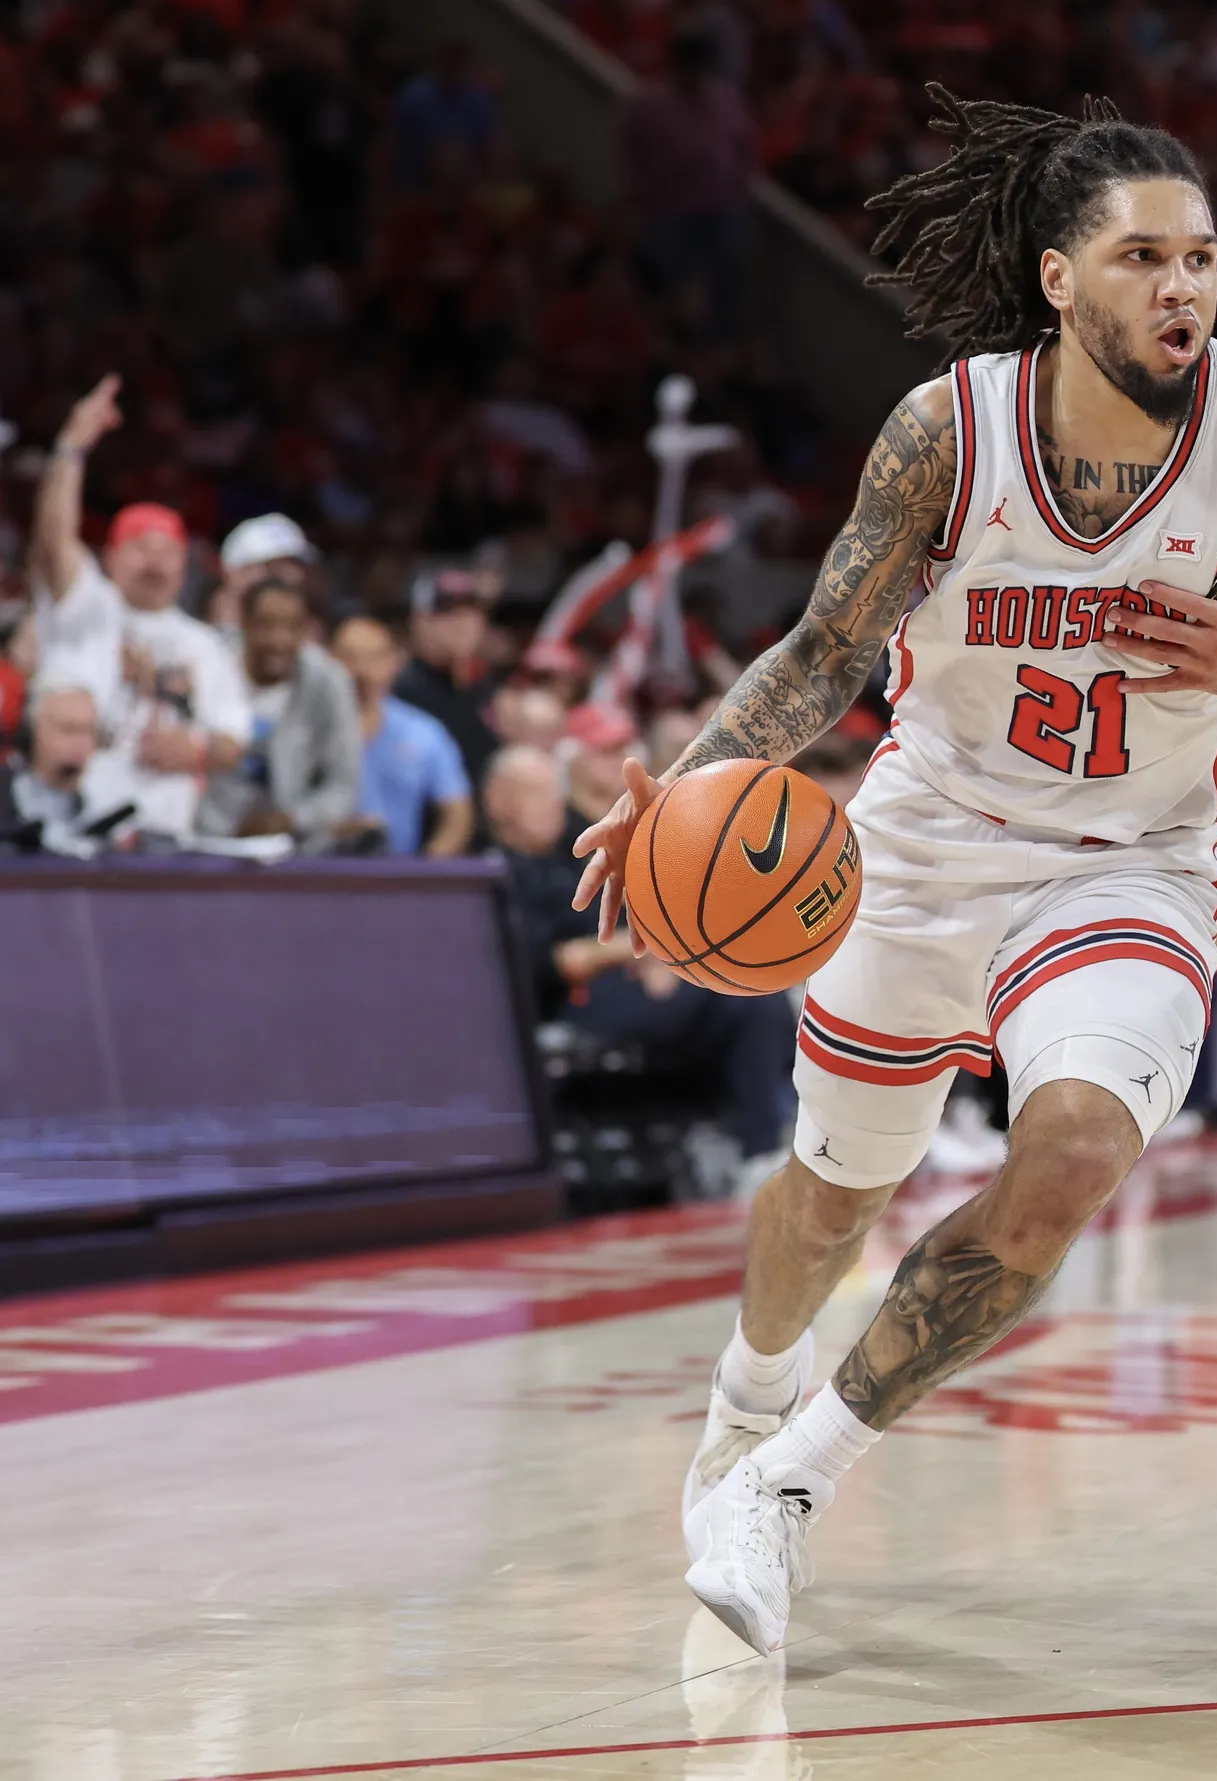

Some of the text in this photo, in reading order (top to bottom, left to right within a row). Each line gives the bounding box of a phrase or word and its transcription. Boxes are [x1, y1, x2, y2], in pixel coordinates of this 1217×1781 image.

[1073, 458, 1103, 490] IN
[1165, 536, 1196, 555] XII
[965, 584, 1187, 668] HOUST
[1007, 663, 1131, 779] 21
